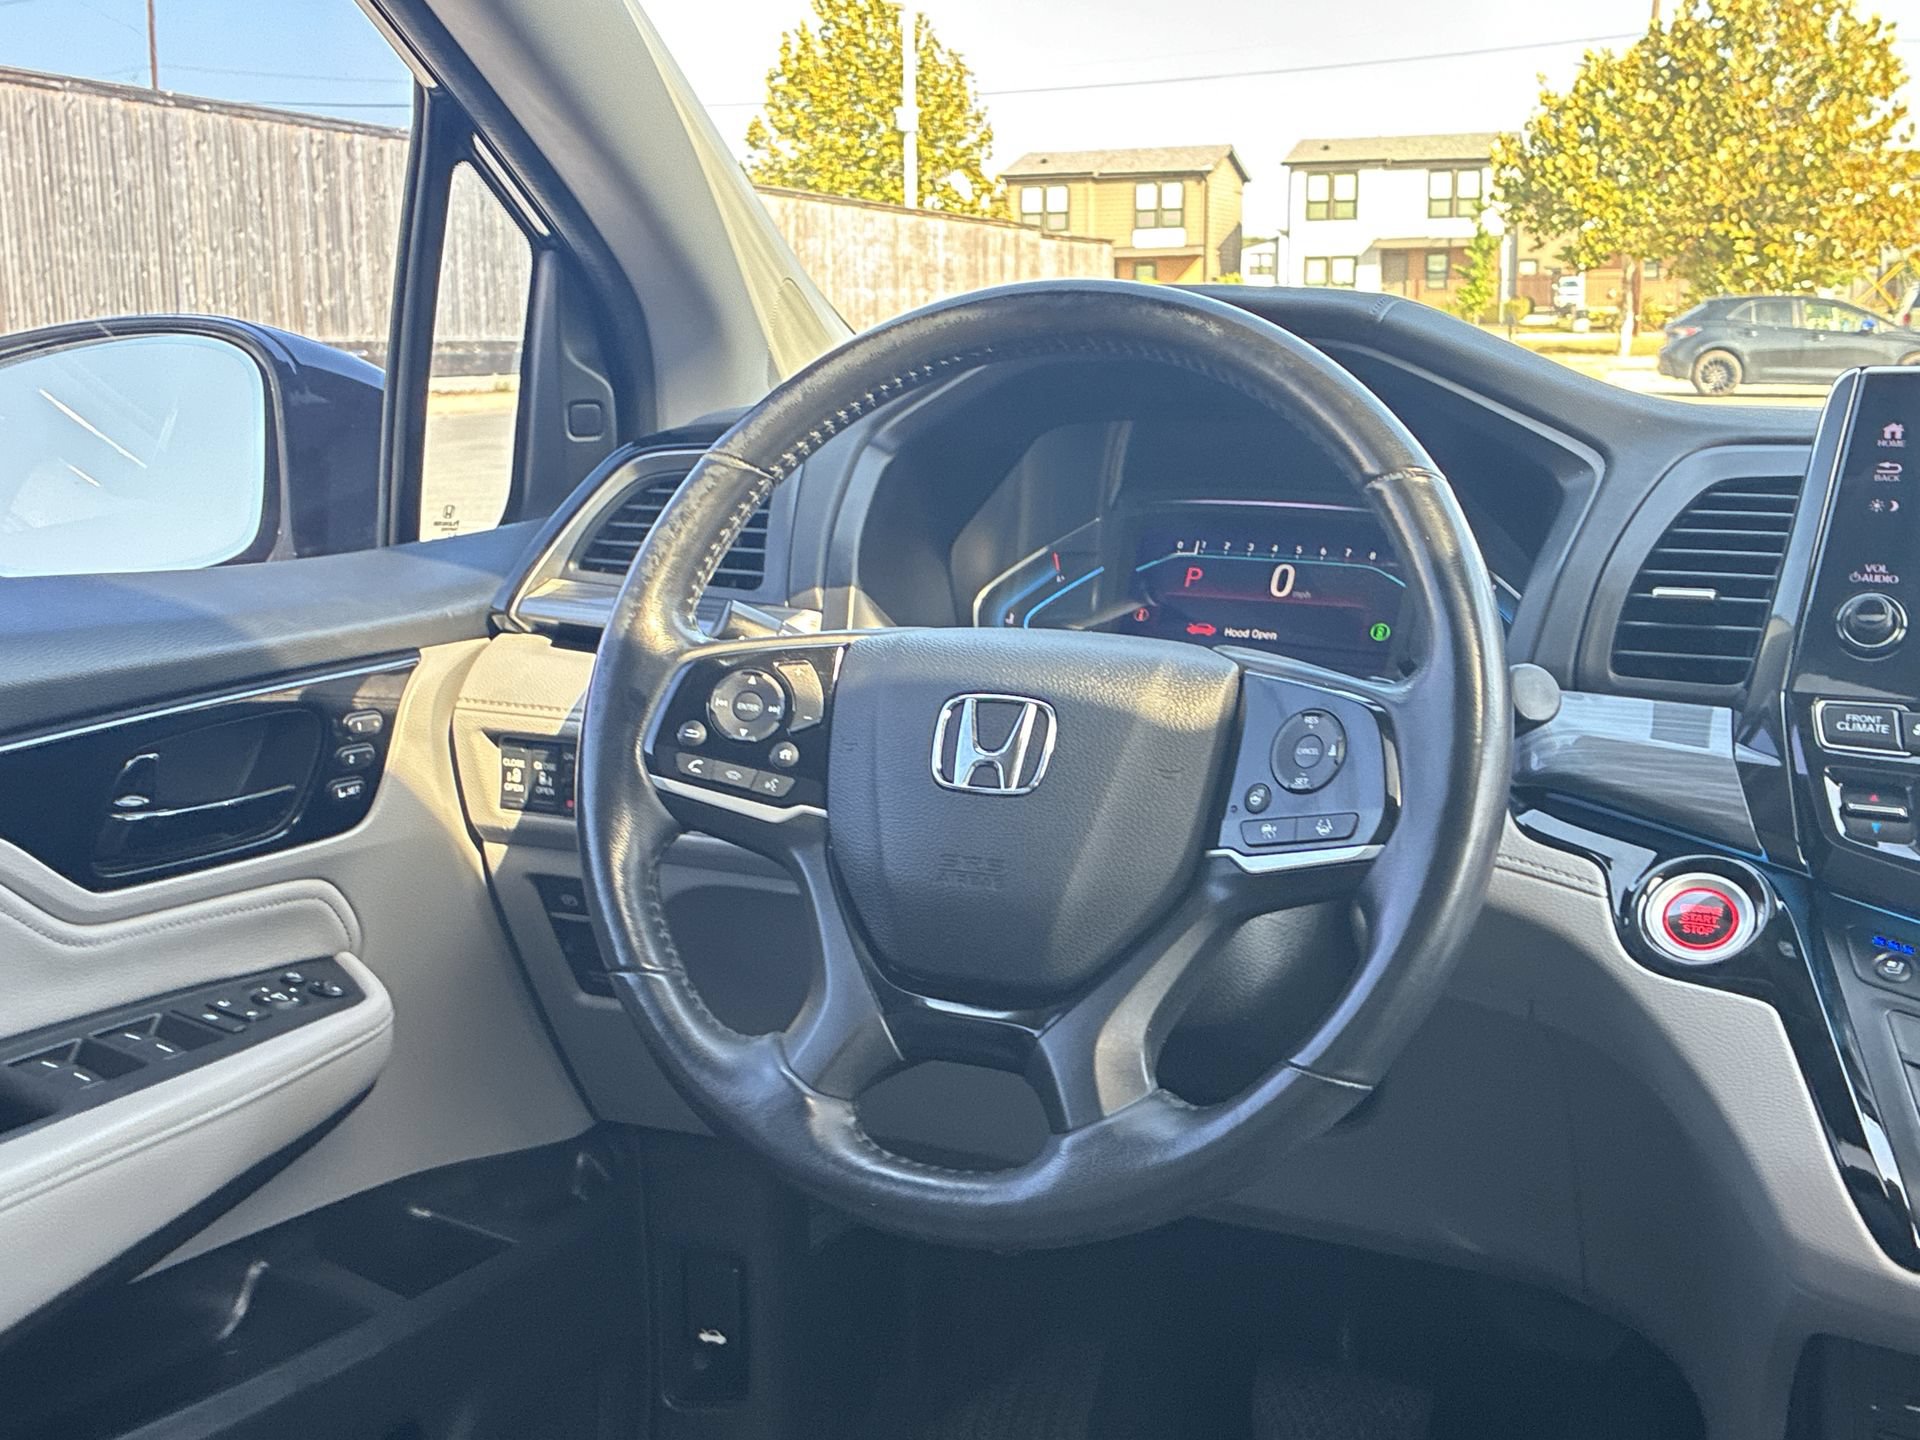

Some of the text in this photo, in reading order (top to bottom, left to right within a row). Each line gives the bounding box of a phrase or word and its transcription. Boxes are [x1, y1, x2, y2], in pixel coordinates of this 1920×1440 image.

[1864, 564, 1888, 574] VOL
[1184, 567, 1203, 587] P
[1270, 563, 1295, 597] 0
[1861, 573, 1899, 584] AUDIO
[1224, 627, 1277, 640] Hood Open
[1845, 713, 1882, 723] FRONT
[1836, 720, 1890, 735] CLIMATE
[502, 757, 525, 768] CLOSE
[503, 782, 525, 792] OPEN
[1681, 911, 1720, 924] START
[1682, 924, 1714, 936] STOP
